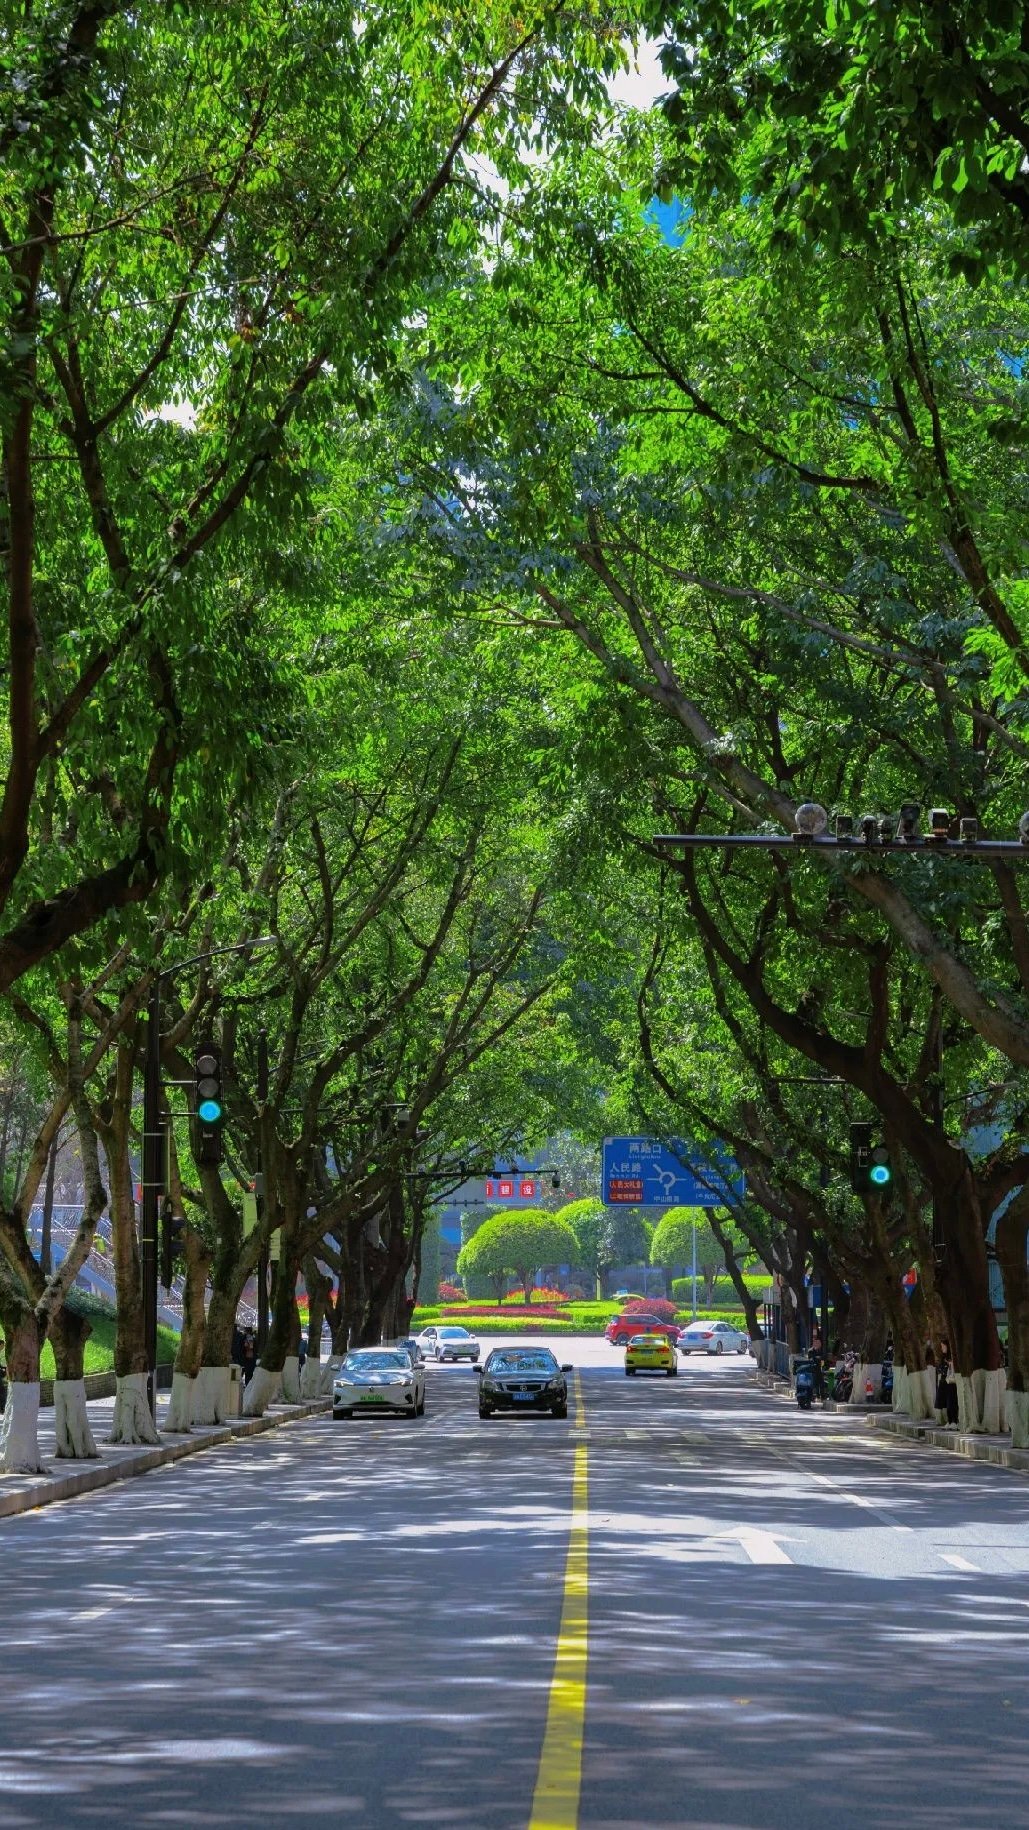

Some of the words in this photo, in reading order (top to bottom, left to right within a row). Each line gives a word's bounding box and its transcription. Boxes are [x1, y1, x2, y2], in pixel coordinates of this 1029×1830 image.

[629, 1142, 662, 1154] 两路口
[609, 1162, 641, 1173] 人民路
